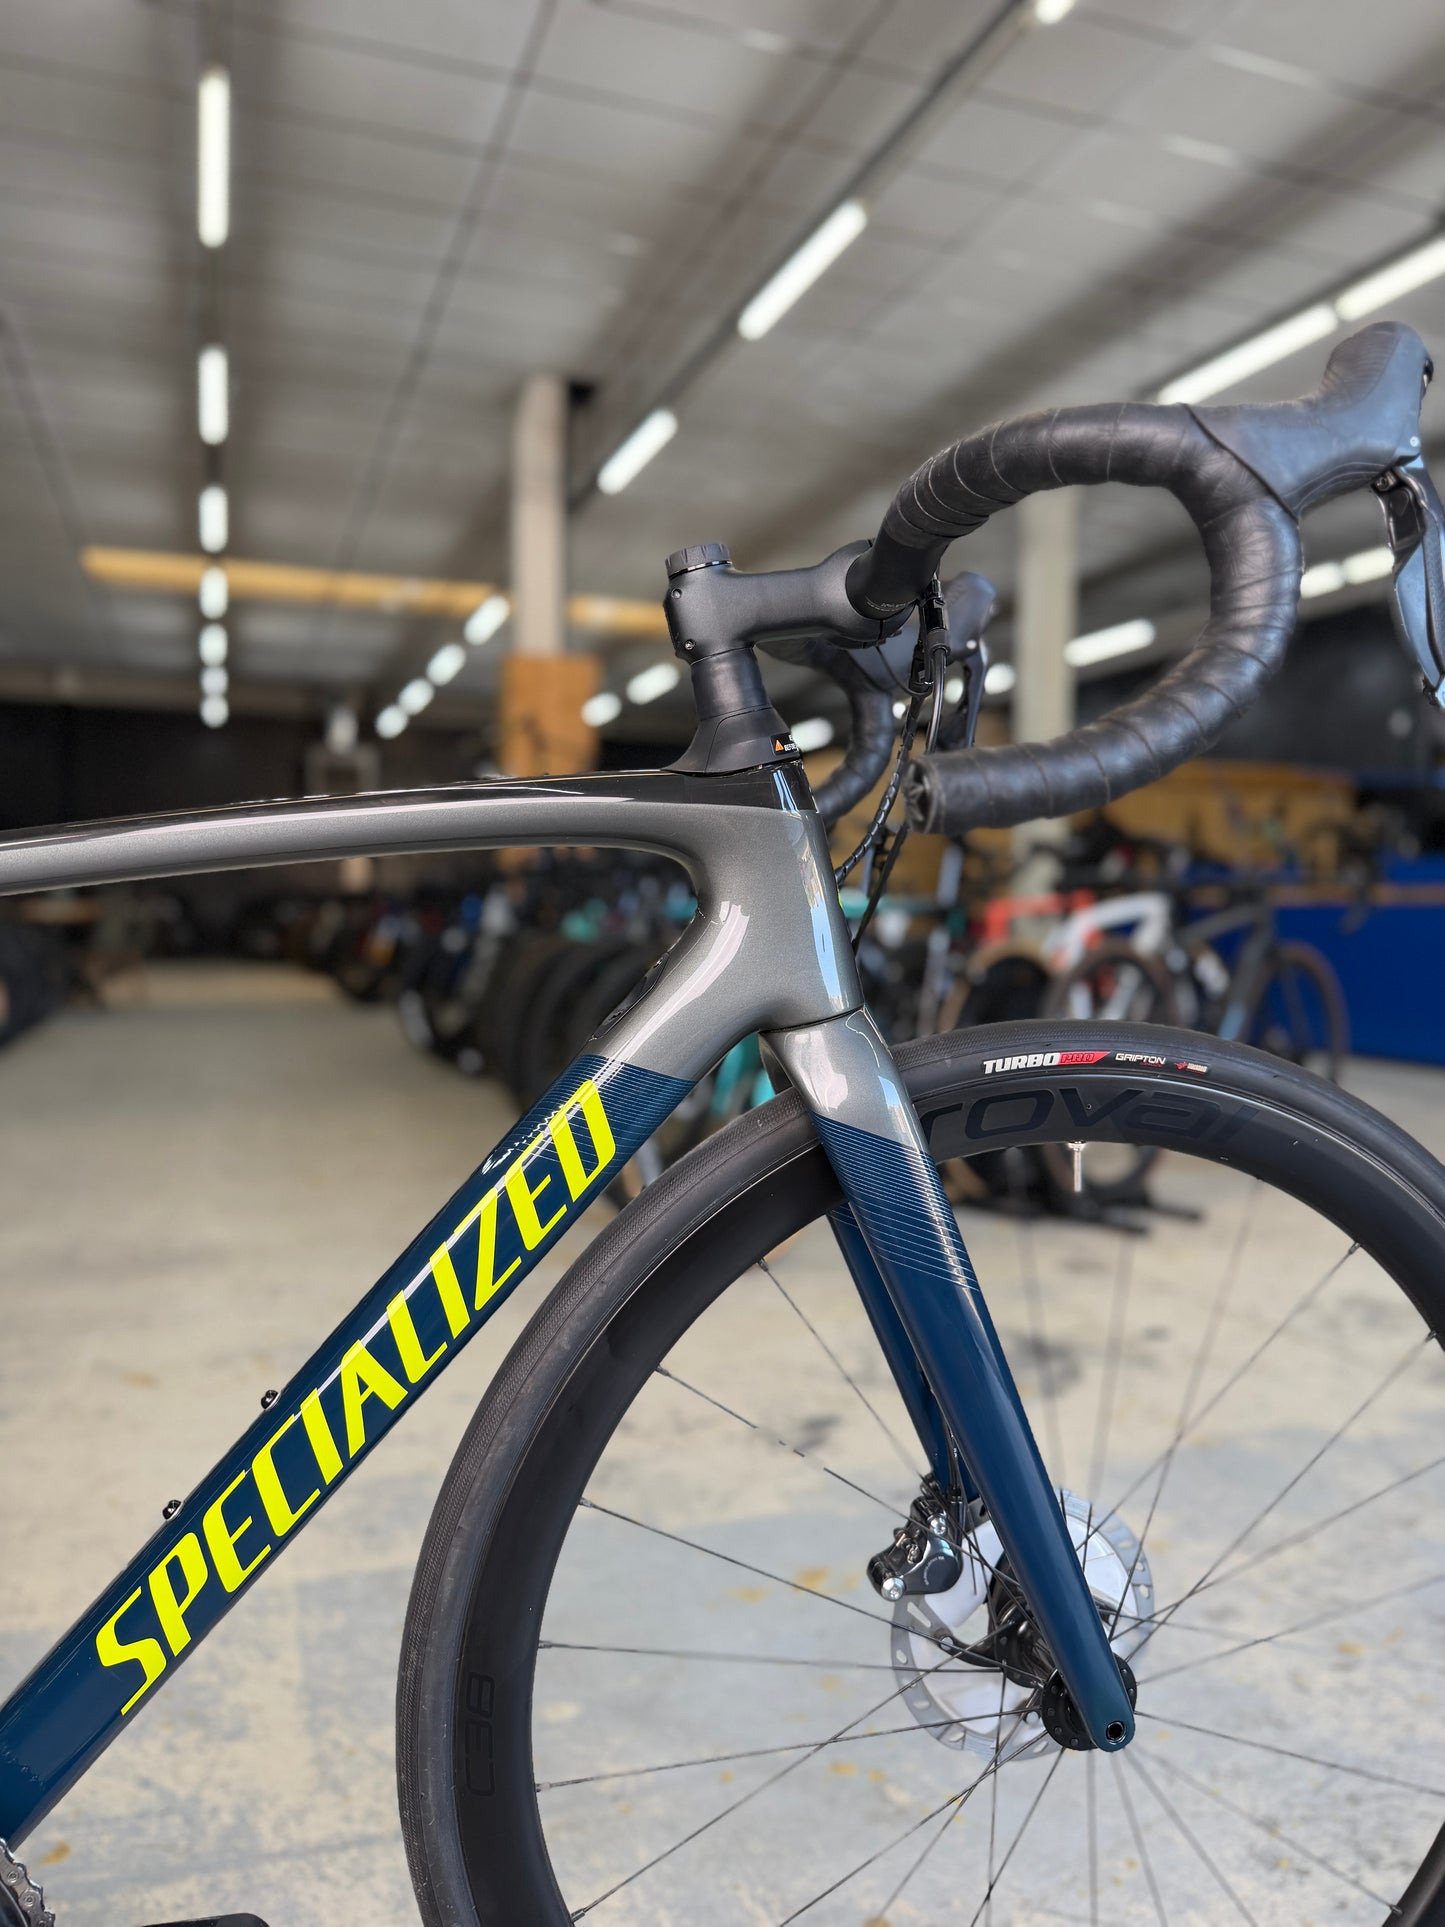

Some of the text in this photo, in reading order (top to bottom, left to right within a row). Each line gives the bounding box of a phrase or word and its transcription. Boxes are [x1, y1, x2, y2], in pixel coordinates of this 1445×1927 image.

[983, 1053, 1095, 1074] TURBO PRO
[1115, 1053, 1166, 1065] GRIPTON
[95, 1080, 616, 1716] SPECIALIZED
[464, 1672, 496, 1796] C38
